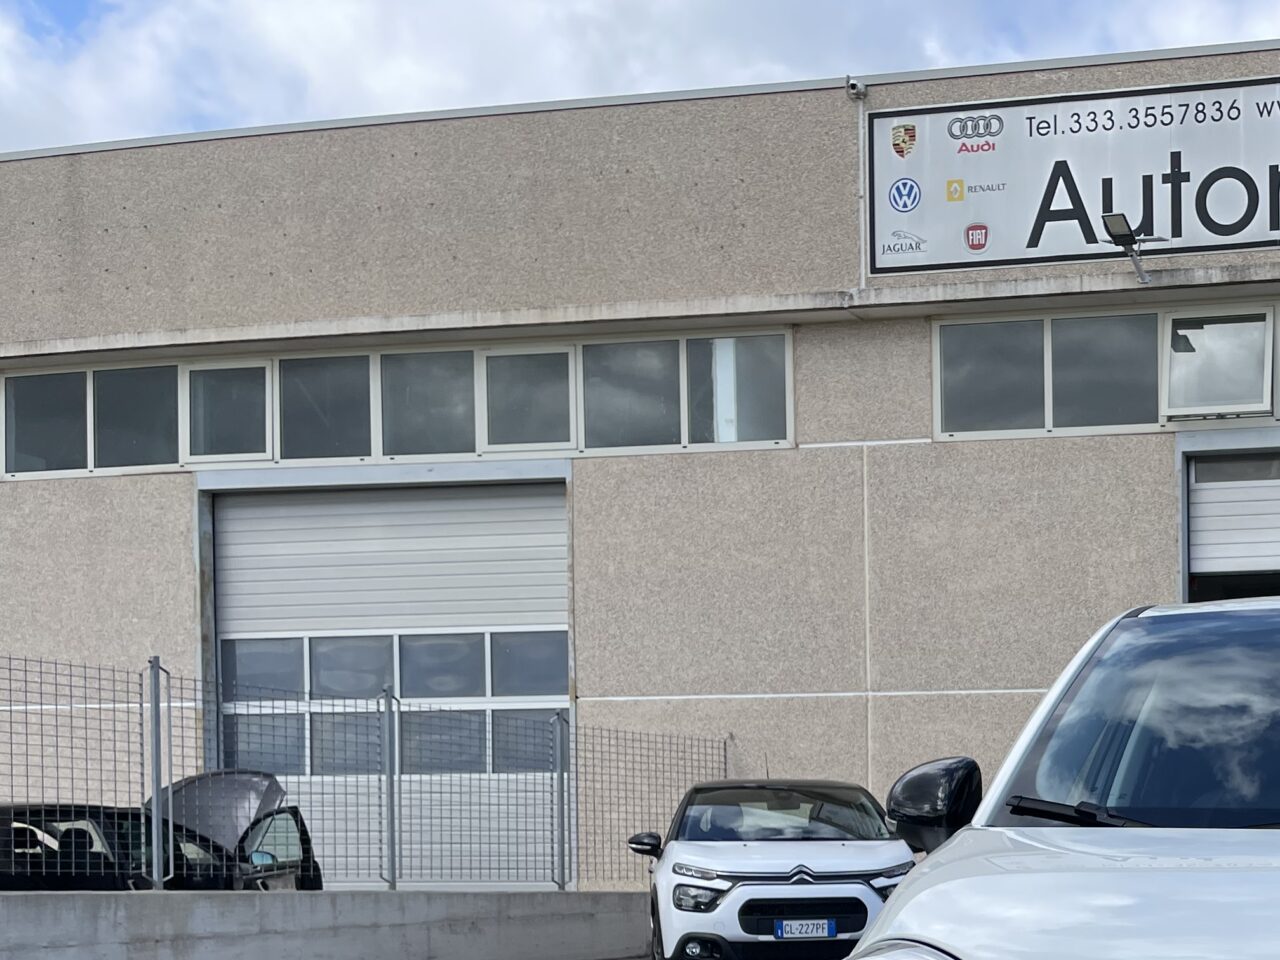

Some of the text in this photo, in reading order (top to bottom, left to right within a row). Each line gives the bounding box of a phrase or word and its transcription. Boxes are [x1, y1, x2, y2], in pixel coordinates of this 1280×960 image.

[957, 140, 996, 154] Audi
[967, 183, 1007, 193] RENAULT
[968, 229, 986, 245] FIAT
[881, 243, 921, 255] JAGUAR
